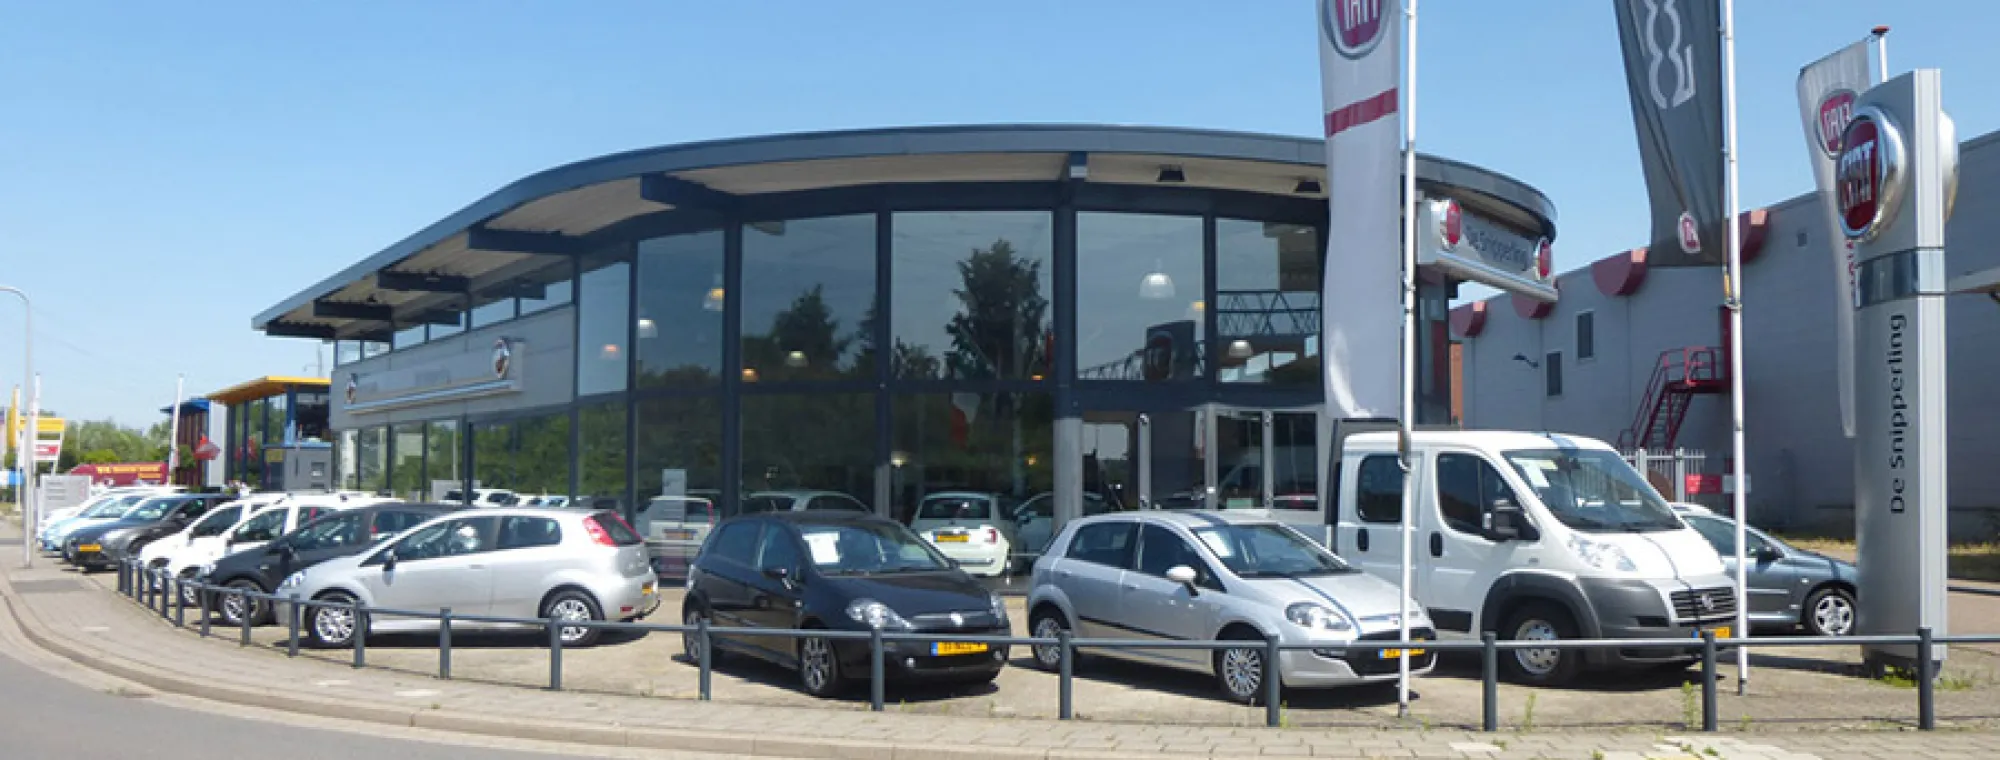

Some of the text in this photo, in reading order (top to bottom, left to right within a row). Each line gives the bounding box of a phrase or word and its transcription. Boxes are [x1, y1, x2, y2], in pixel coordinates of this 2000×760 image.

[1842, 140, 1874, 210] FIAT
[1887, 314, 1908, 514] De Snipperling
